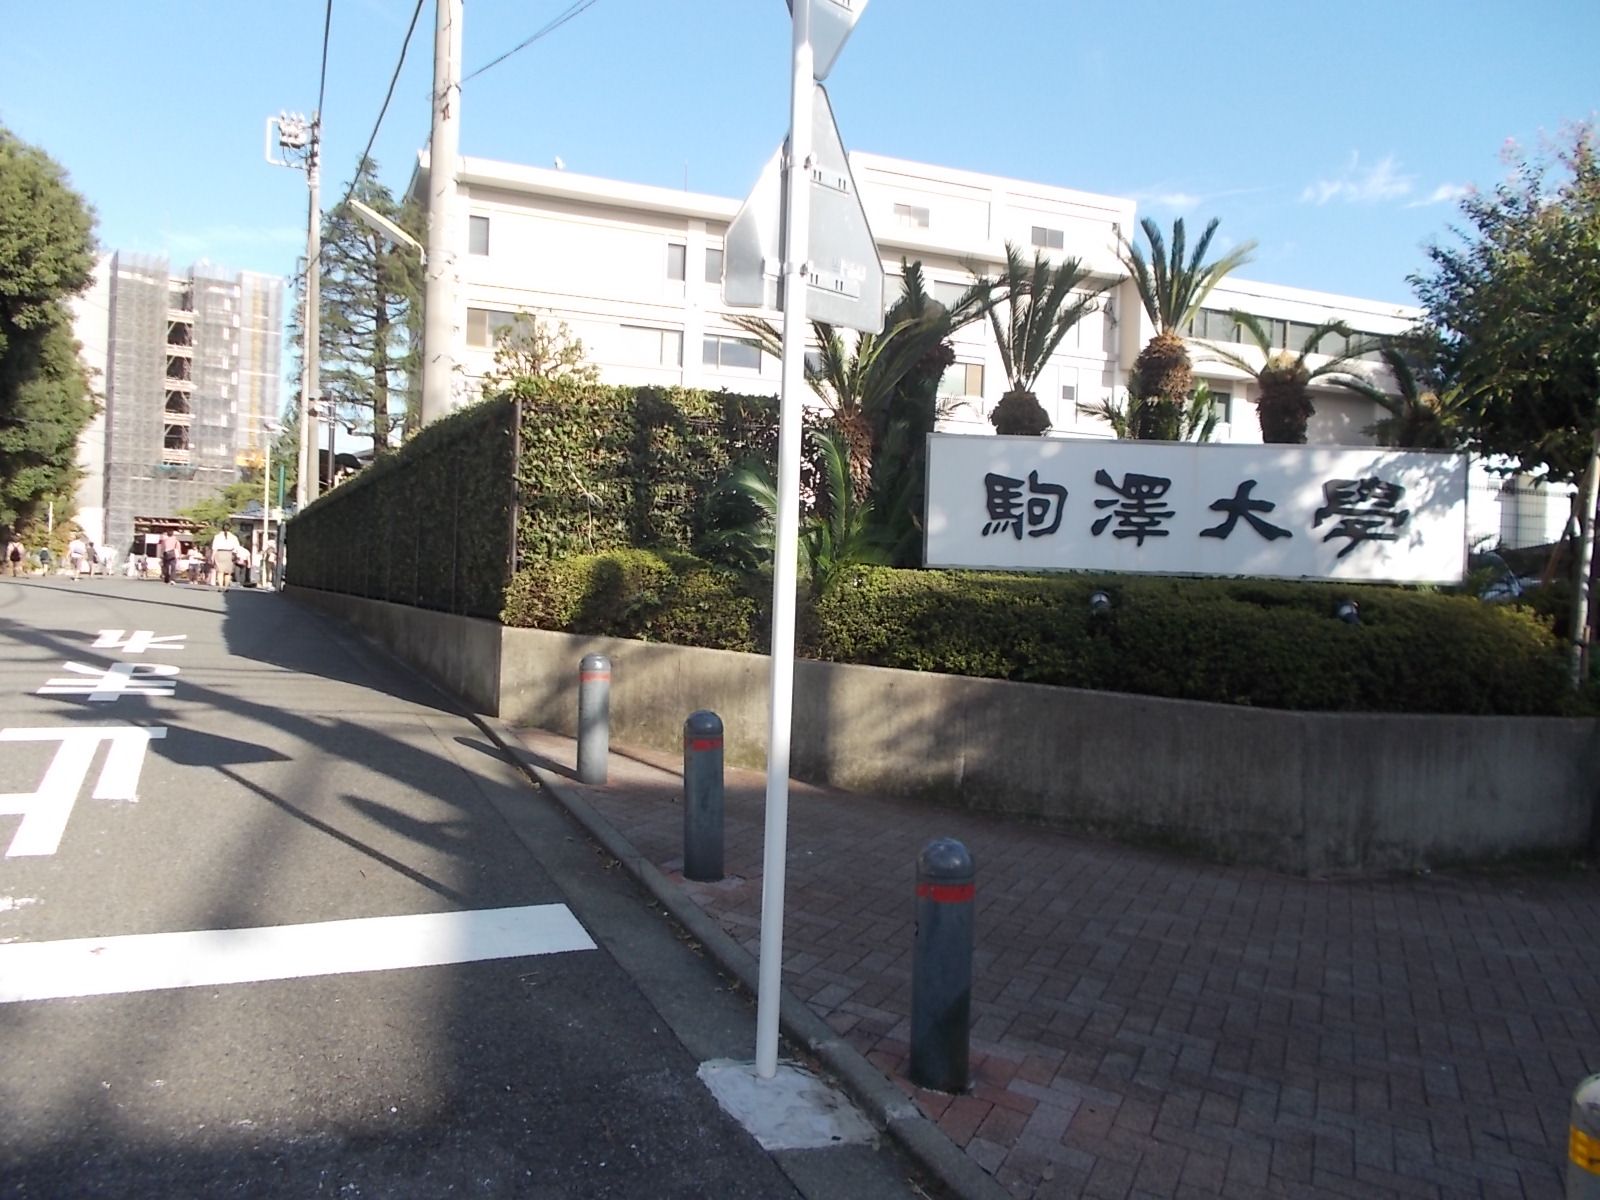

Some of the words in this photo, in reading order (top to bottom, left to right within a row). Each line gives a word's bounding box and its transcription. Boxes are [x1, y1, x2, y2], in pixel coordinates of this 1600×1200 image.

[982, 469, 1410, 559] 駒澤大學
[0, 628, 188, 857] 止まれ
